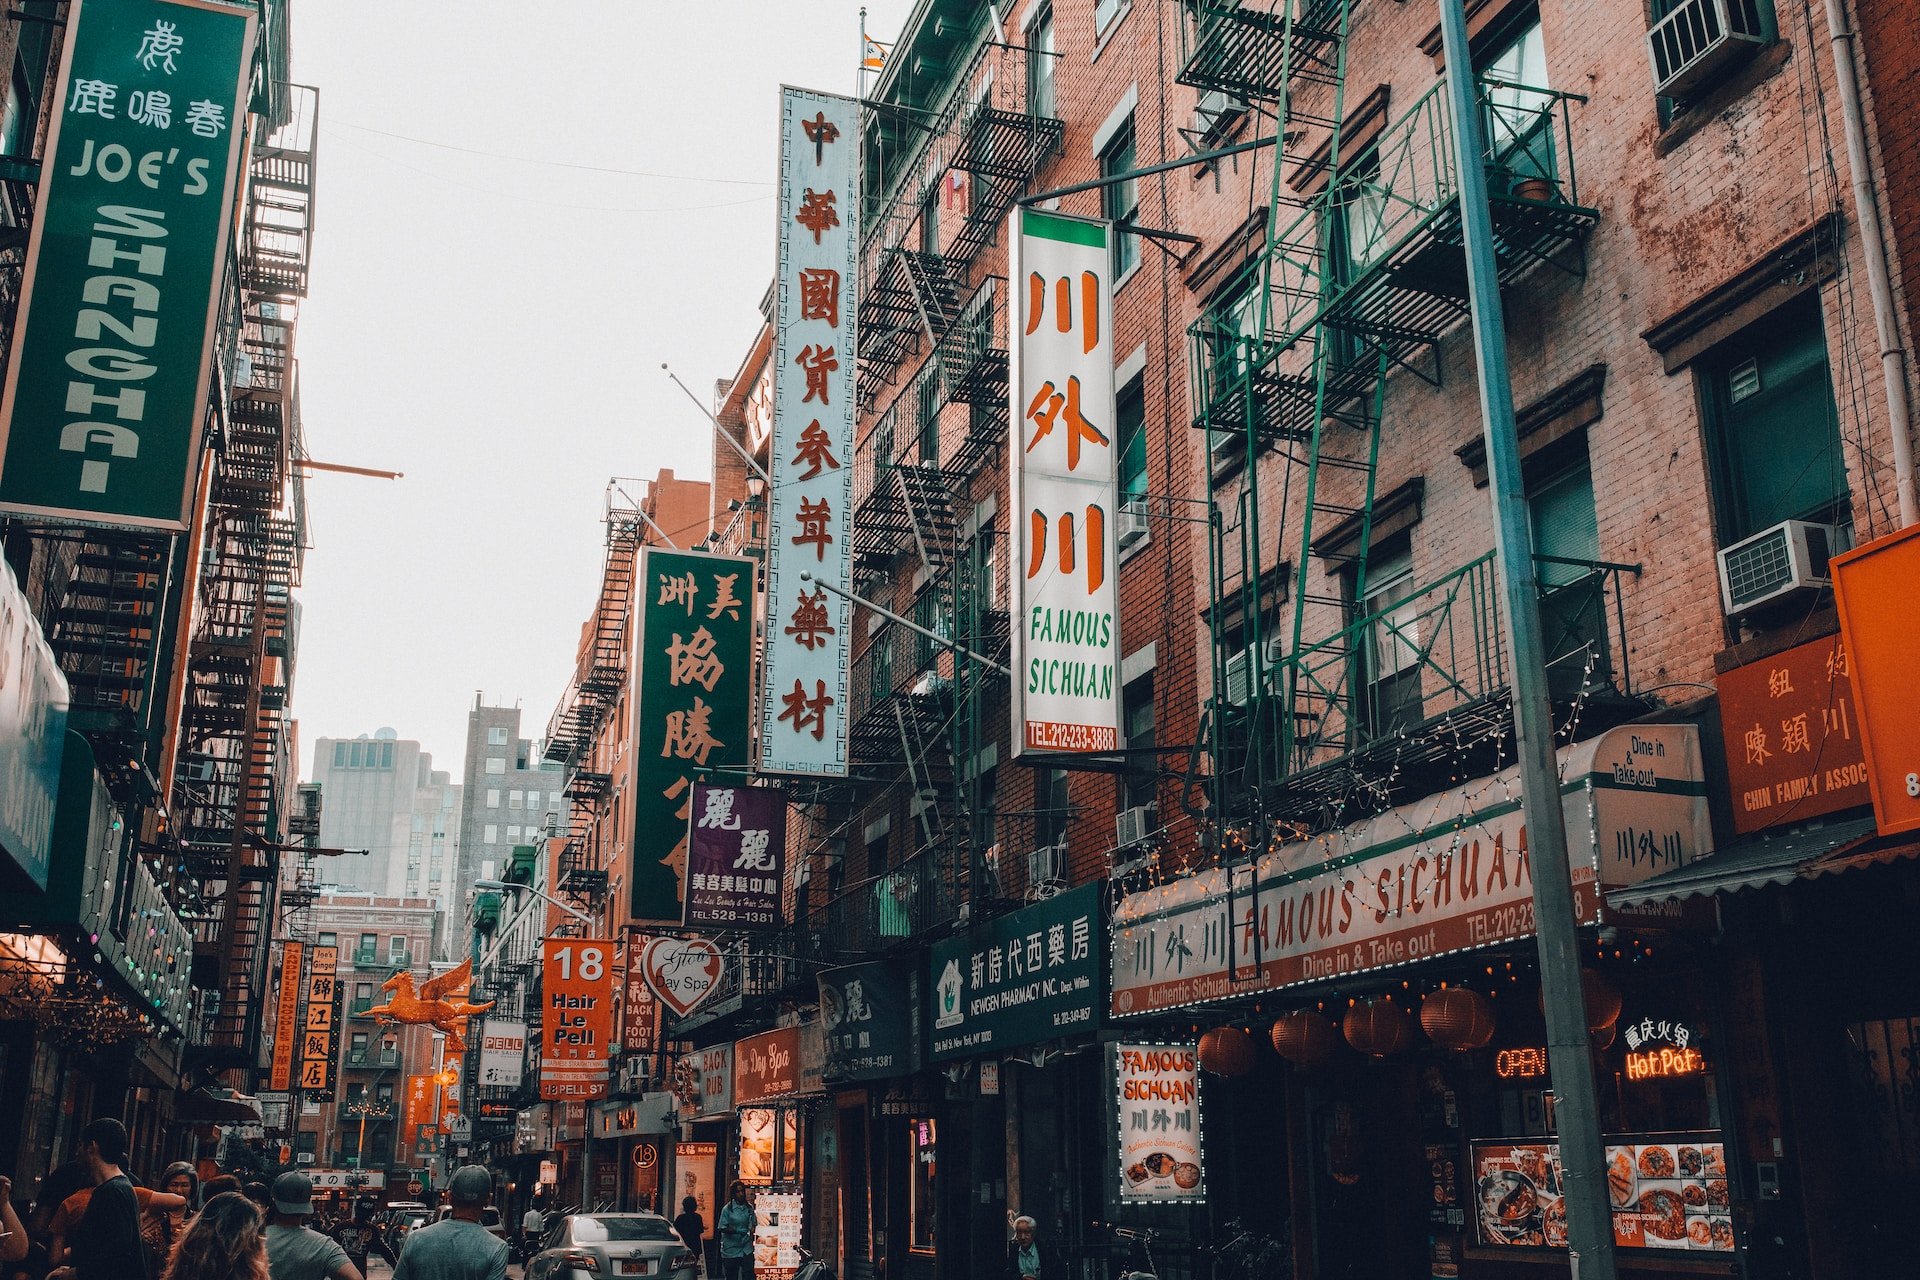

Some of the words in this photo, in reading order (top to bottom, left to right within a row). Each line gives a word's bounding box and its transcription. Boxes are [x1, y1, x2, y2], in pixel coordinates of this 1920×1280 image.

[68, 77, 227, 139] 鹿鳴春
[70, 140, 210, 196] JOE'S
[58, 204, 170, 494] SHANGHAI
[1025, 269, 1111, 597] 川外川
[1030, 606, 1112, 648] FAMOUS
[1028, 657, 1113, 701] SICHUAN
[1768, 643, 1850, 699] 紐約
[1028, 721, 1115, 751] TEL:212-233-3888
[1631, 735, 1654, 757] Dine
[1656, 743, 1665, 758] in
[1626, 750, 1634, 765] &
[1612, 762, 1637, 784] Take
[1638, 769, 1656, 787] out
[1743, 786, 1772, 812] CHIN
[1776, 774, 1819, 804] FAMILY
[1617, 827, 1683, 869] 川外川
[691, 872, 777, 895] 美容美髮中心
[1243, 880, 1354, 957] FAMOUS
[317, 950, 333, 959] Joe's
[970, 915, 1090, 990] 新時代西藥房
[1135, 912, 1226, 980] 川外川
[1302, 954, 1333, 980] Dine
[1336, 948, 1350, 973] in
[1353, 943, 1365, 968] &
[1368, 934, 1404, 964] Take
[1408, 927, 1437, 955] out
[313, 960, 335, 970] Ginger
[553, 946, 604, 981] 18
[655, 975, 680, 992] Day
[683, 975, 709, 993] Spa
[970, 995, 1000, 1017] NEWGEN
[1001, 981, 1042, 1009] PHARMACY
[1042, 977, 1058, 998] INC.
[1147, 982, 1190, 1007] Authentic
[1192, 977, 1230, 1001] Sichuan
[1233, 968, 1271, 991] Cuisine
[552, 993, 599, 1010] Hair
[626, 1004, 653, 1015] BACK
[303, 977, 332, 1086] 錦江飯店
[560, 1012, 588, 1029] Le
[625, 1027, 652, 1037] FOOT
[635, 1016, 643, 1026] &
[485, 1036, 522, 1051] PELL
[554, 1029, 595, 1046] Pell
[628, 1038, 648, 1048] RUB
[703, 1049, 727, 1073] BACK
[768, 1042, 790, 1078] Spa
[981, 1065, 997, 1077] ATM
[1122, 1051, 1196, 1077] FAMOUS
[1497, 1048, 1546, 1077] OPEN
[1626, 1052, 1658, 1079] Hot
[1660, 1048, 1695, 1076] Pot
[545, 1084, 558, 1096] 18
[559, 1085, 588, 1095] PELL
[590, 1083, 605, 1094] ST
[706, 1076, 724, 1097] RUB
[1123, 1075, 1196, 1106] SICHUAN
[1130, 1108, 1192, 1132] 川外川
[638, 1145, 652, 1163] 18
